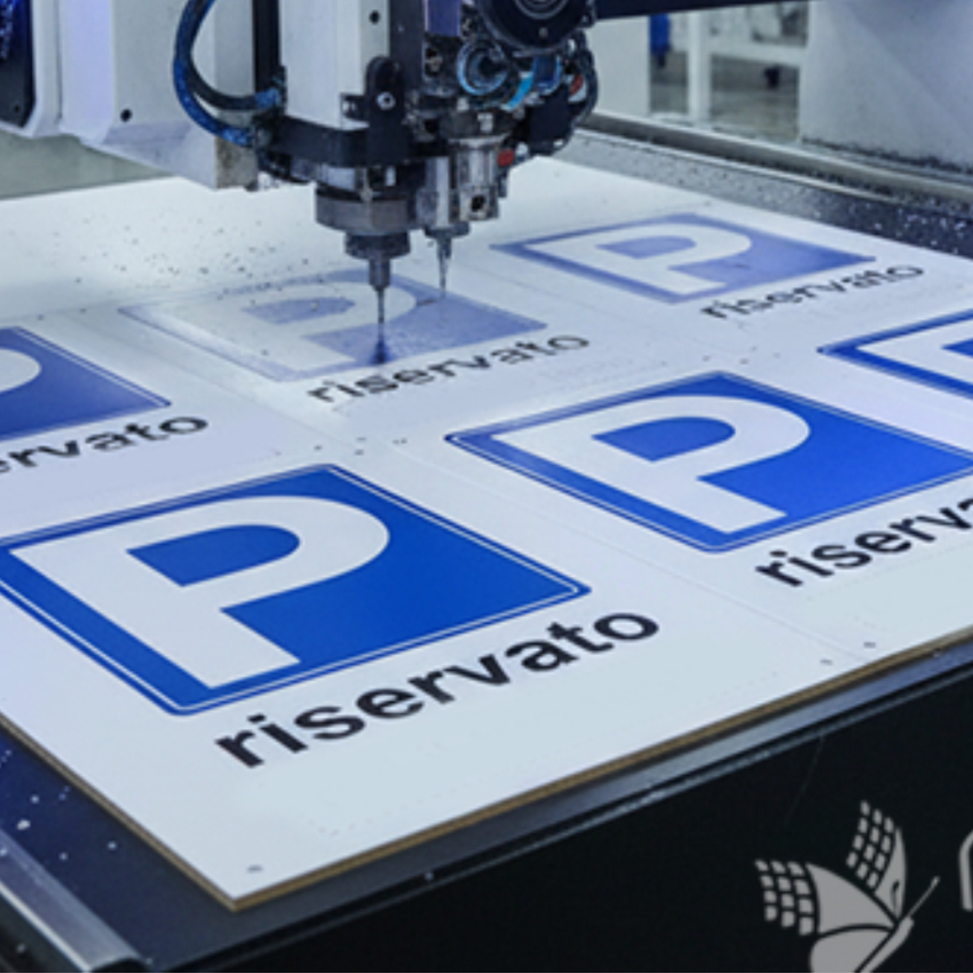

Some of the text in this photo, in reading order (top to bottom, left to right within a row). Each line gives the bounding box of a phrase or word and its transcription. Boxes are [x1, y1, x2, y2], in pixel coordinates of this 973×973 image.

[524, 224, 752, 295] P
[701, 263, 925, 320] riservato
[145, 281, 418, 372] P
[307, 334, 590, 403] riservato
[0, 417, 209, 473] rvato
[491, 395, 811, 534] P
[8, 495, 391, 690] P
[215, 612, 659, 768] riservato
